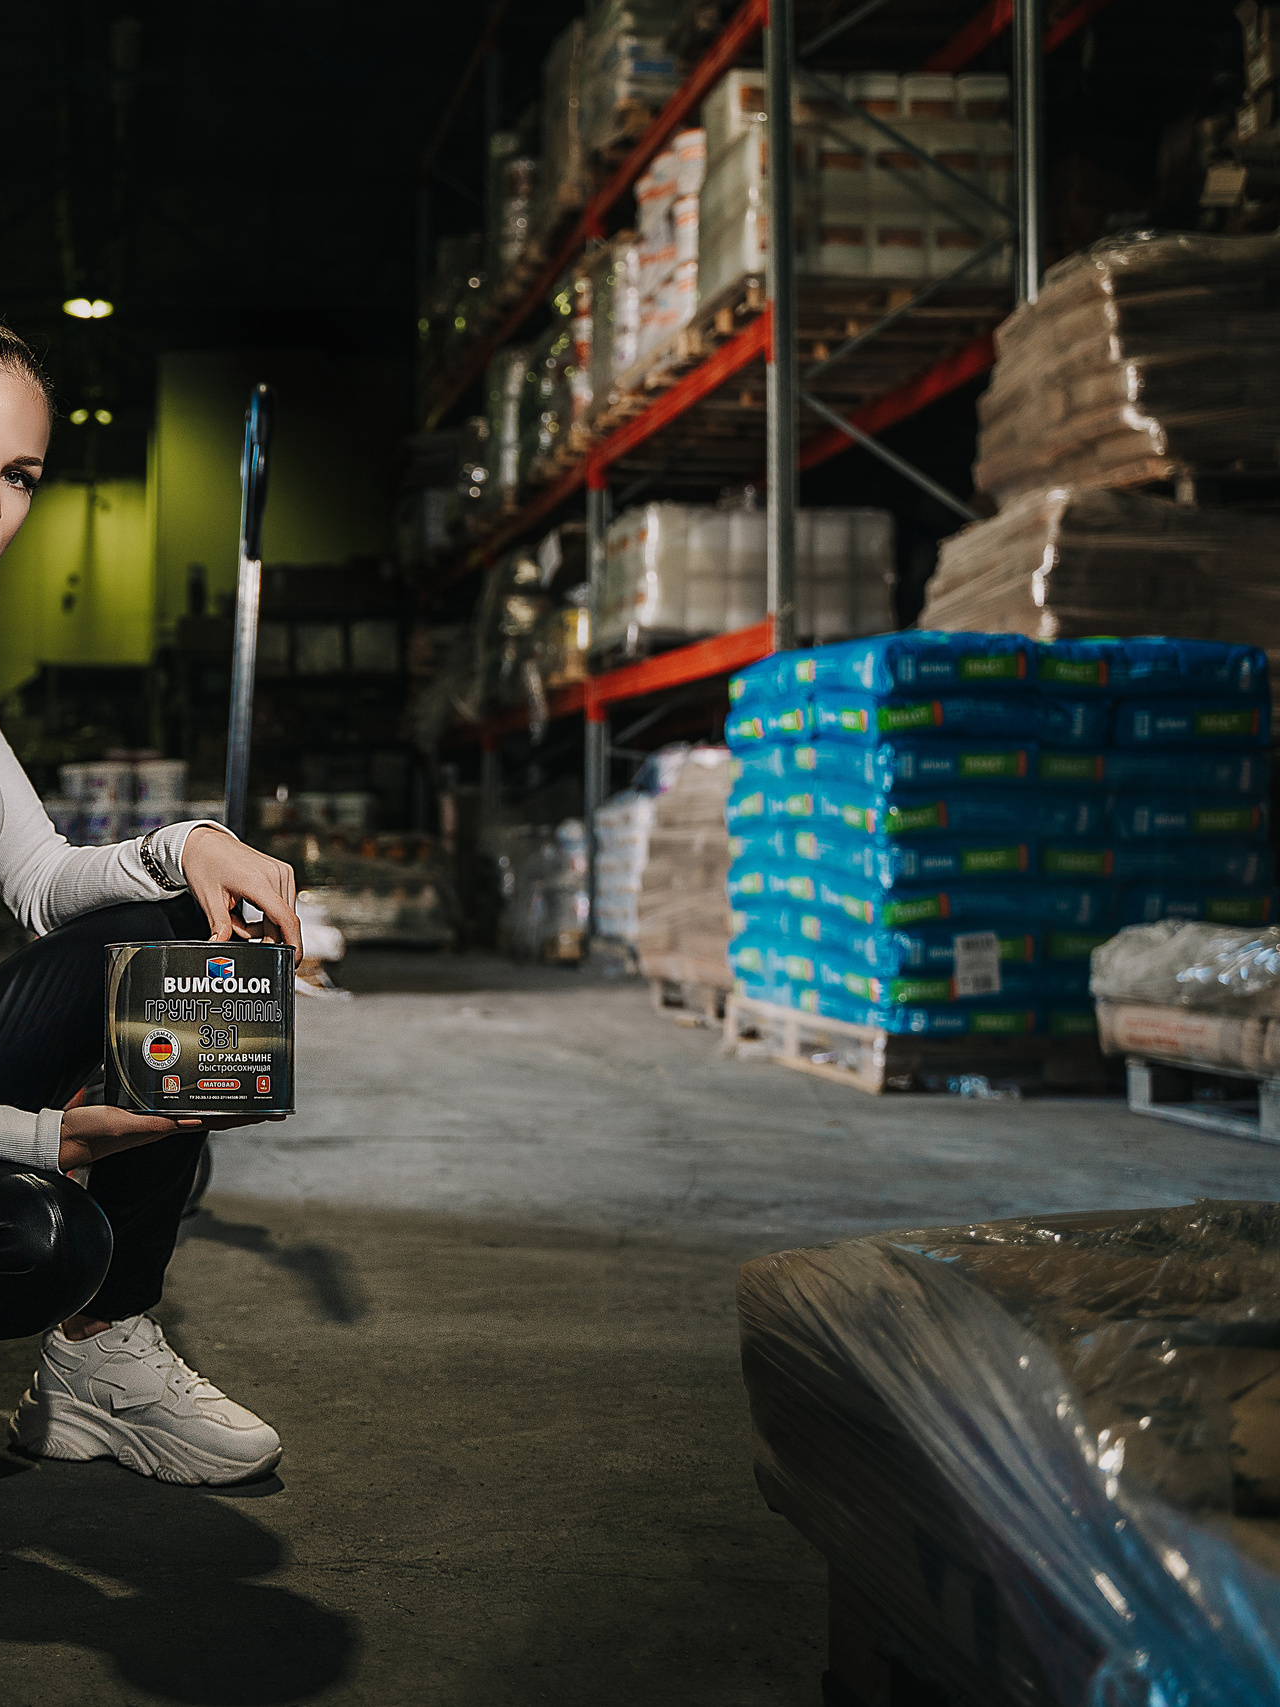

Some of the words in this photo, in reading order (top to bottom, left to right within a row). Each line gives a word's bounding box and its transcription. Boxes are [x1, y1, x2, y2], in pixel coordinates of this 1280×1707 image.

[163, 976, 271, 994] BUMCOLOR
[144, 999, 283, 1023] ГРУНТ-ЭМАЛЬ
[149, 1030, 174, 1041] GERMAN
[145, 1052, 177, 1068] TECHNOLOGY
[198, 1053, 215, 1062] ПО
[218, 1053, 272, 1063] РЖАВЧИНЕ
[198, 1062, 271, 1074] быстросохнущая
[202, 1081, 236, 1089] МАТОВАЯ
